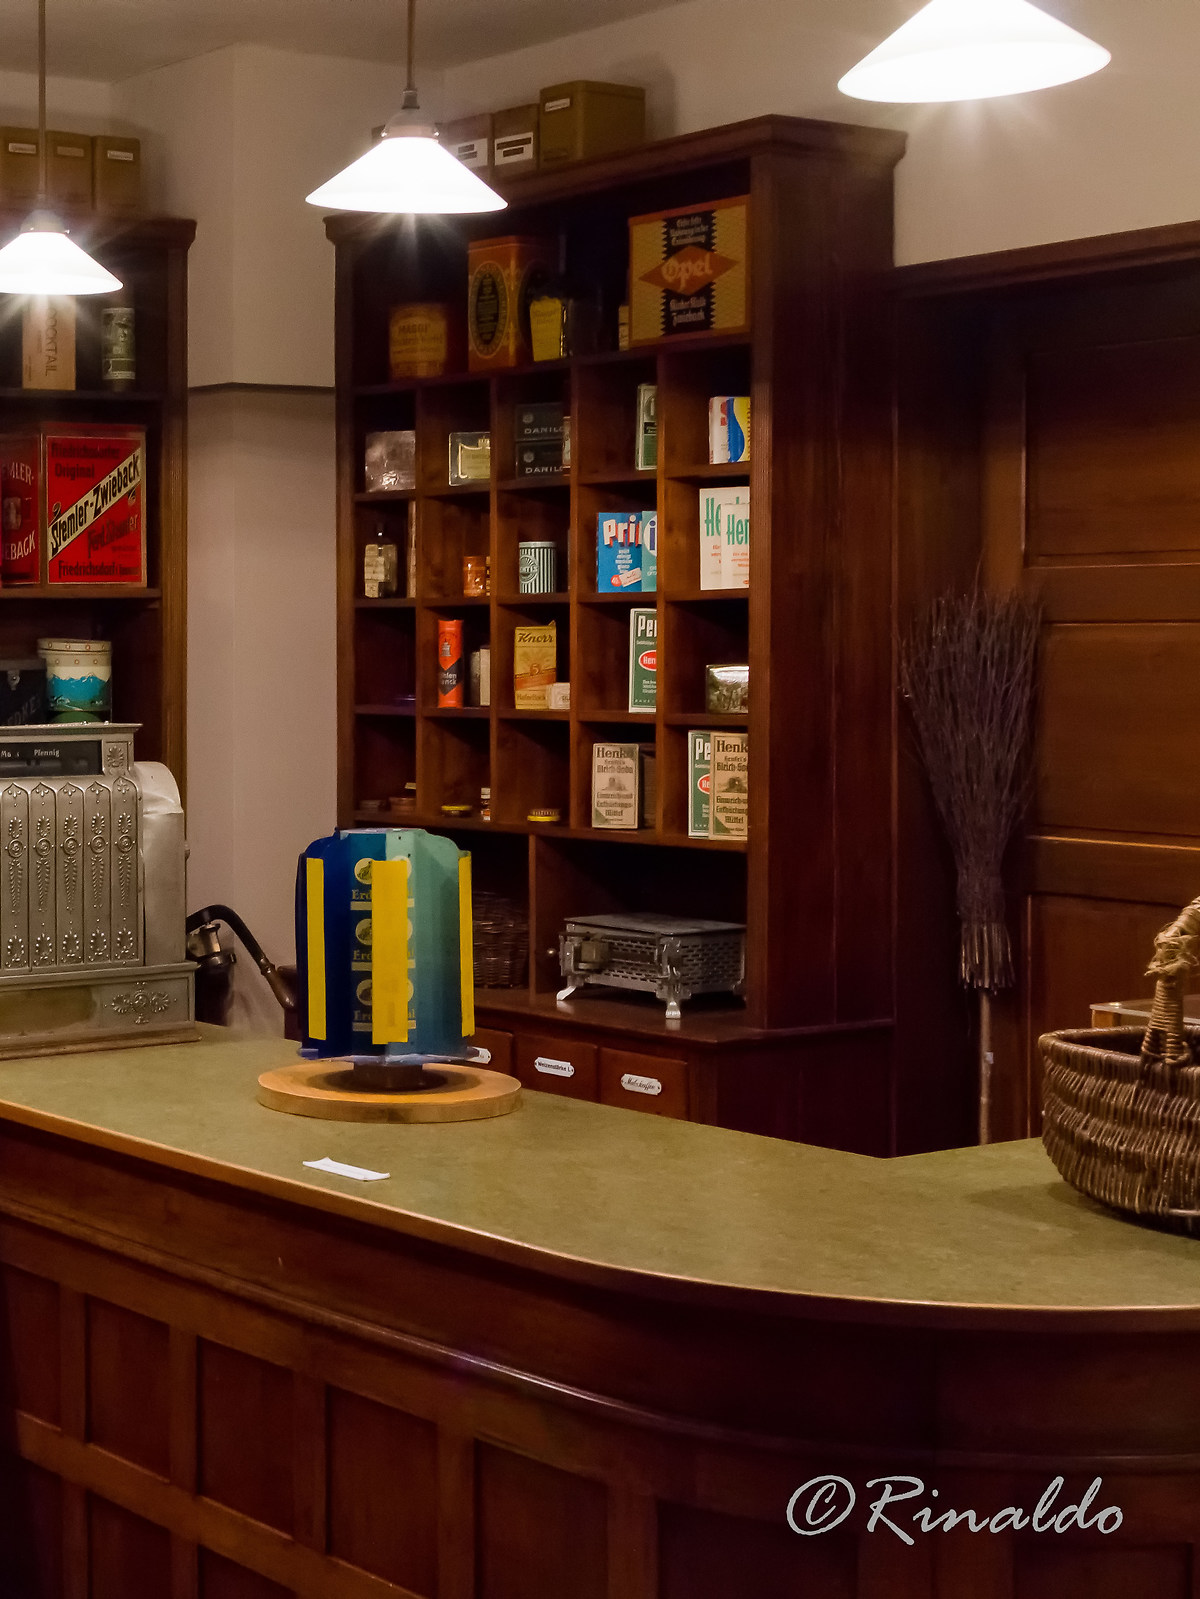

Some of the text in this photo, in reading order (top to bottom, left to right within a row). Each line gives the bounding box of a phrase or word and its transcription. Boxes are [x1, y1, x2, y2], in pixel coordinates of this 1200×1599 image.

[603, 514, 642, 546] Pril
[518, 632, 553, 643] Knorr
[716, 740, 749, 753] Henk
[33, 749, 60, 758] Pfennig
[596, 747, 635, 759] Henk
